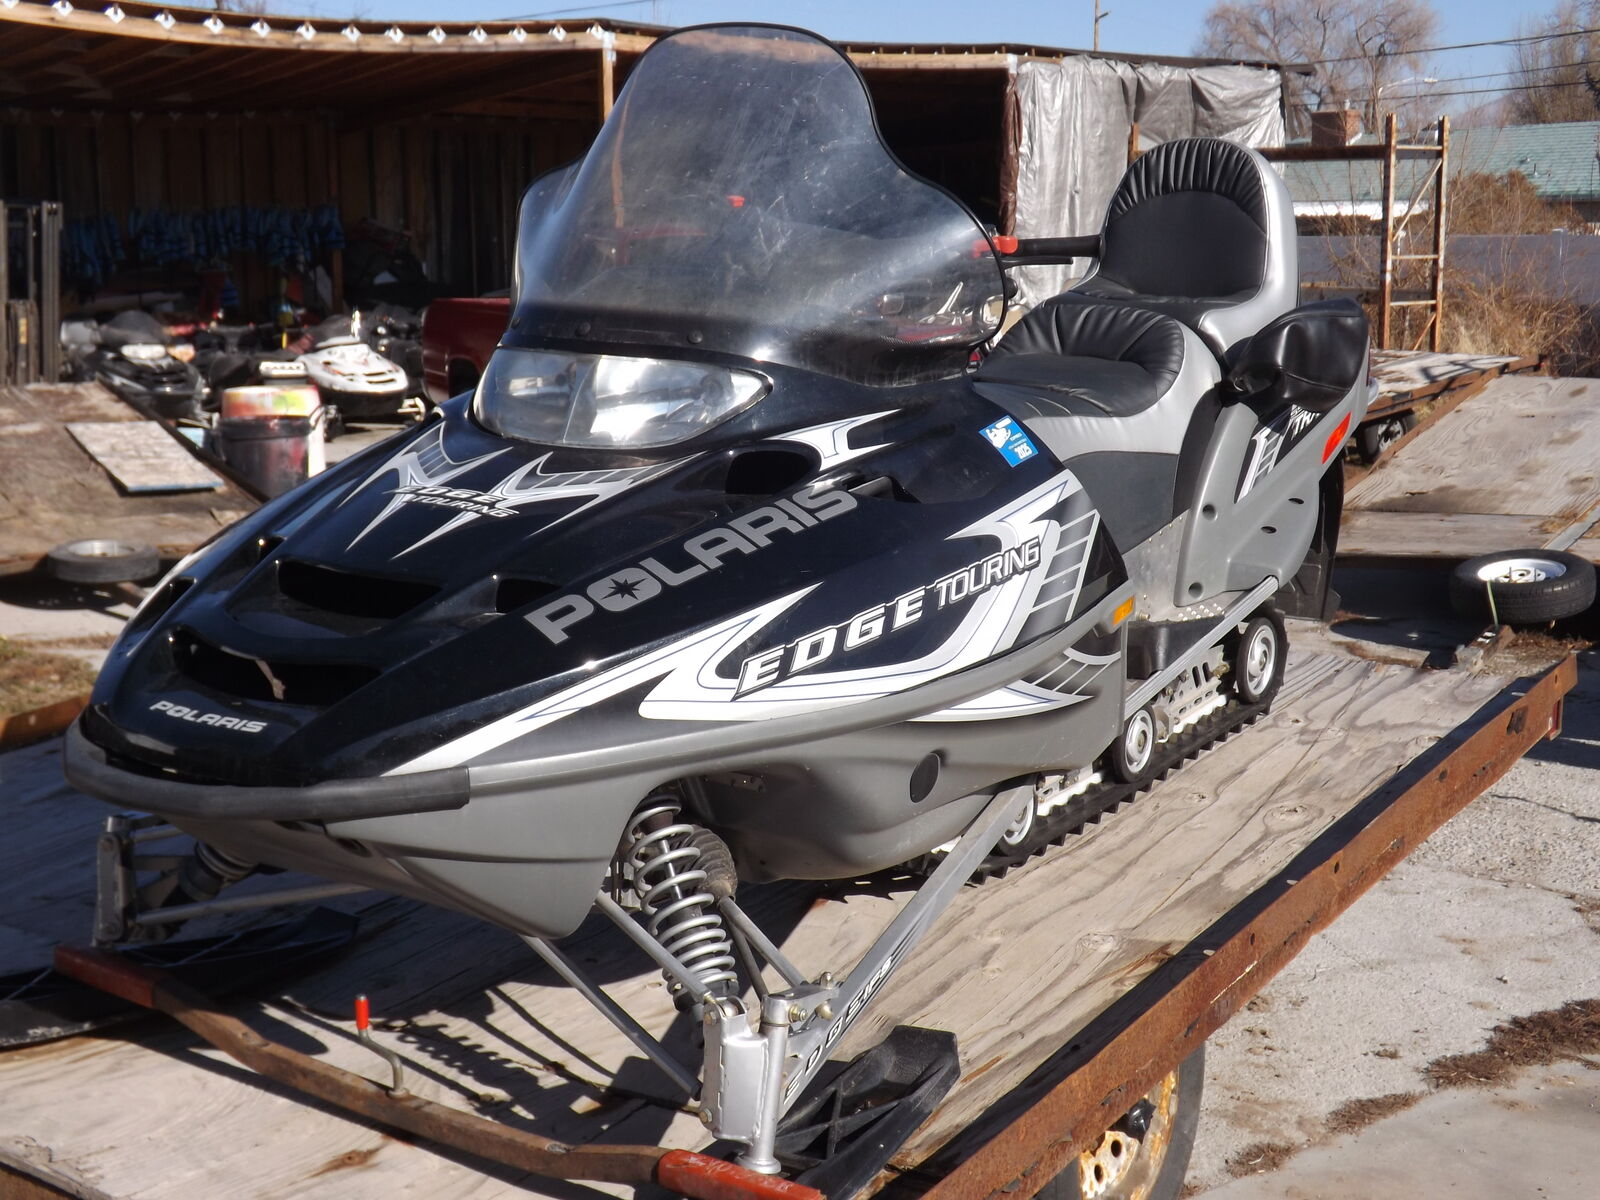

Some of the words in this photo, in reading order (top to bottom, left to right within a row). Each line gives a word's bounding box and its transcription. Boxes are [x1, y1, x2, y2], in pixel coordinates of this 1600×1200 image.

[393, 486, 505, 504] EDGE
[411, 495, 520, 518] TOURING
[524, 489, 858, 645] POLARIS
[731, 587, 925, 700] EDGE
[935, 537, 1042, 609] TOURING
[149, 700, 268, 733] POLARIS
[783, 988, 864, 1105] EDGE
